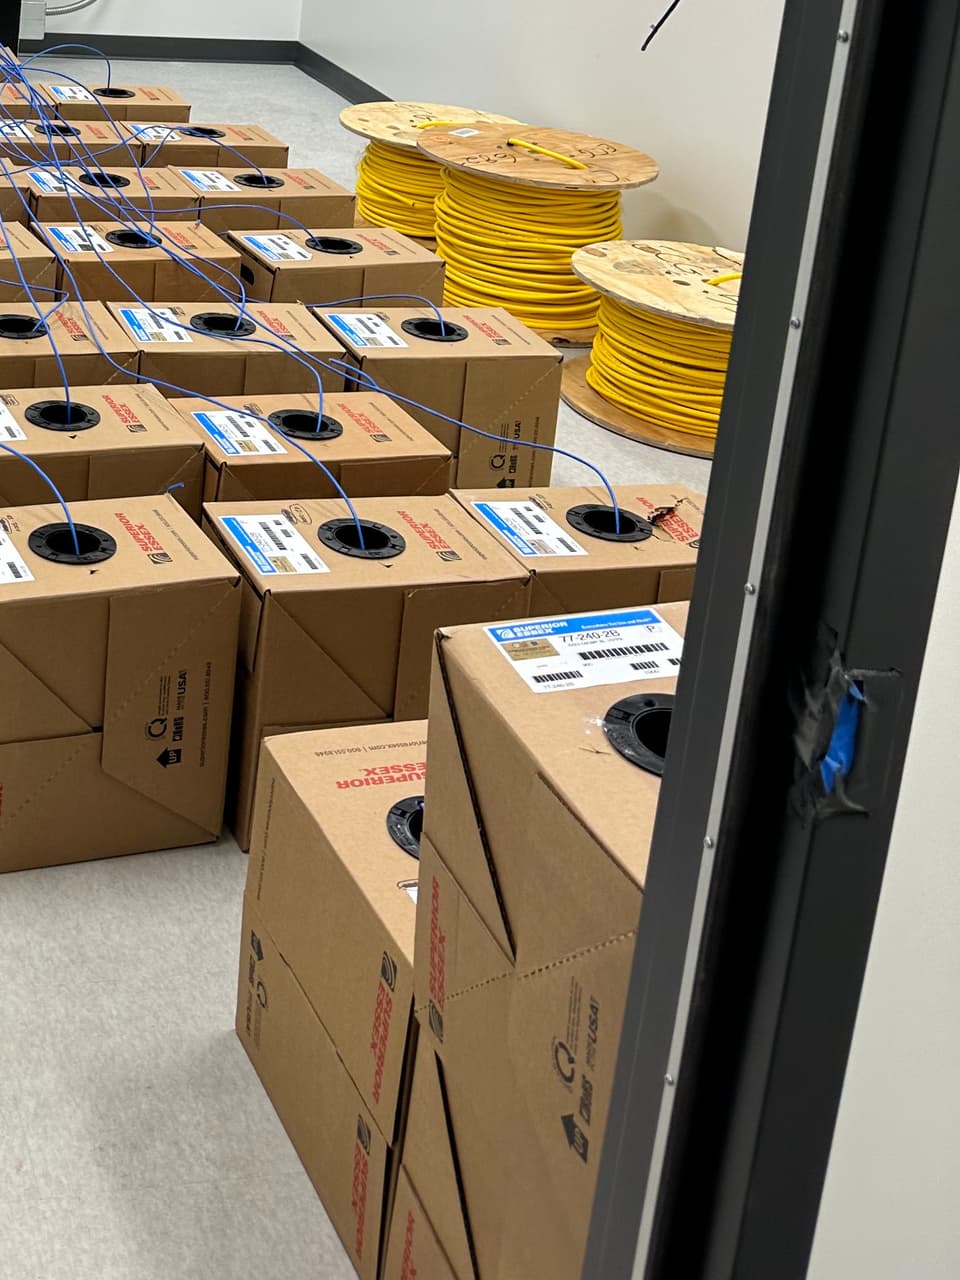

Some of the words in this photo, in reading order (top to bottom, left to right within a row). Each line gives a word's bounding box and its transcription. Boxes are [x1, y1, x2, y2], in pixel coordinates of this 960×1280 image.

[114, 513, 153, 552] SUPERIOR
[135, 523, 164, 551] ESSEX
[513, 621, 568, 633] SUPERIOR
[516, 629, 555, 637] ESSEX
[560, 629, 620, 643] 77-240-2B
[363, 762, 427, 776] ESSEX
[429, 875, 440, 1001] SUPERIOR
[438, 929, 446, 1013] ESSEX
[371, 980, 386, 1054] ESSEX
[373, 991, 393, 1105] SUPERIOR
[355, 1152, 369, 1261] SUPERIOR
